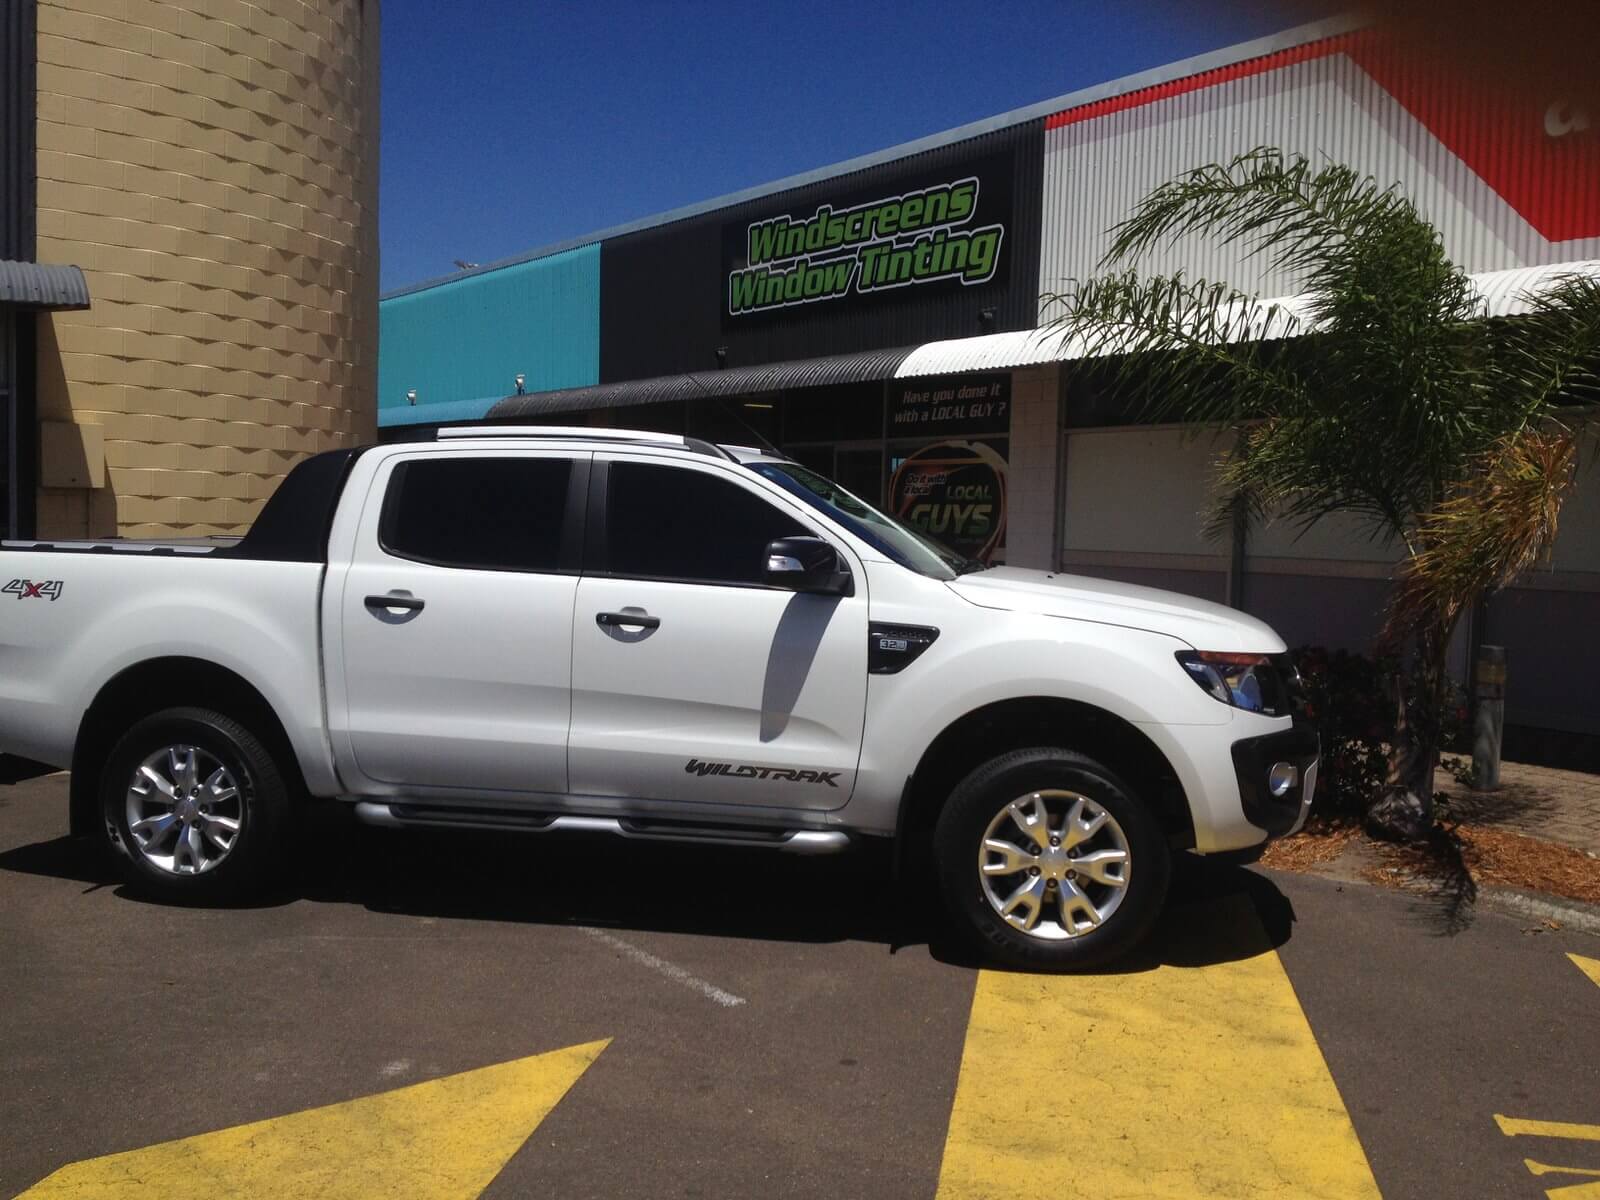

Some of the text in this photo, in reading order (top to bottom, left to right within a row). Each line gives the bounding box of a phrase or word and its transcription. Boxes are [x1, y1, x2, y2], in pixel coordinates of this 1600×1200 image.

[749, 178, 978, 265] Windscreens
[730, 226, 1001, 313] Window Tinting
[903, 384, 1001, 404] Have you done it
[895, 409, 918, 423] with
[920, 412, 929, 421] a
[931, 405, 966, 420] LOCAL
[969, 402, 994, 417] GUY
[946, 485, 992, 500] LOCAL
[911, 503, 992, 534] GUYS
[685, 759, 843, 788] WILDTRAK
